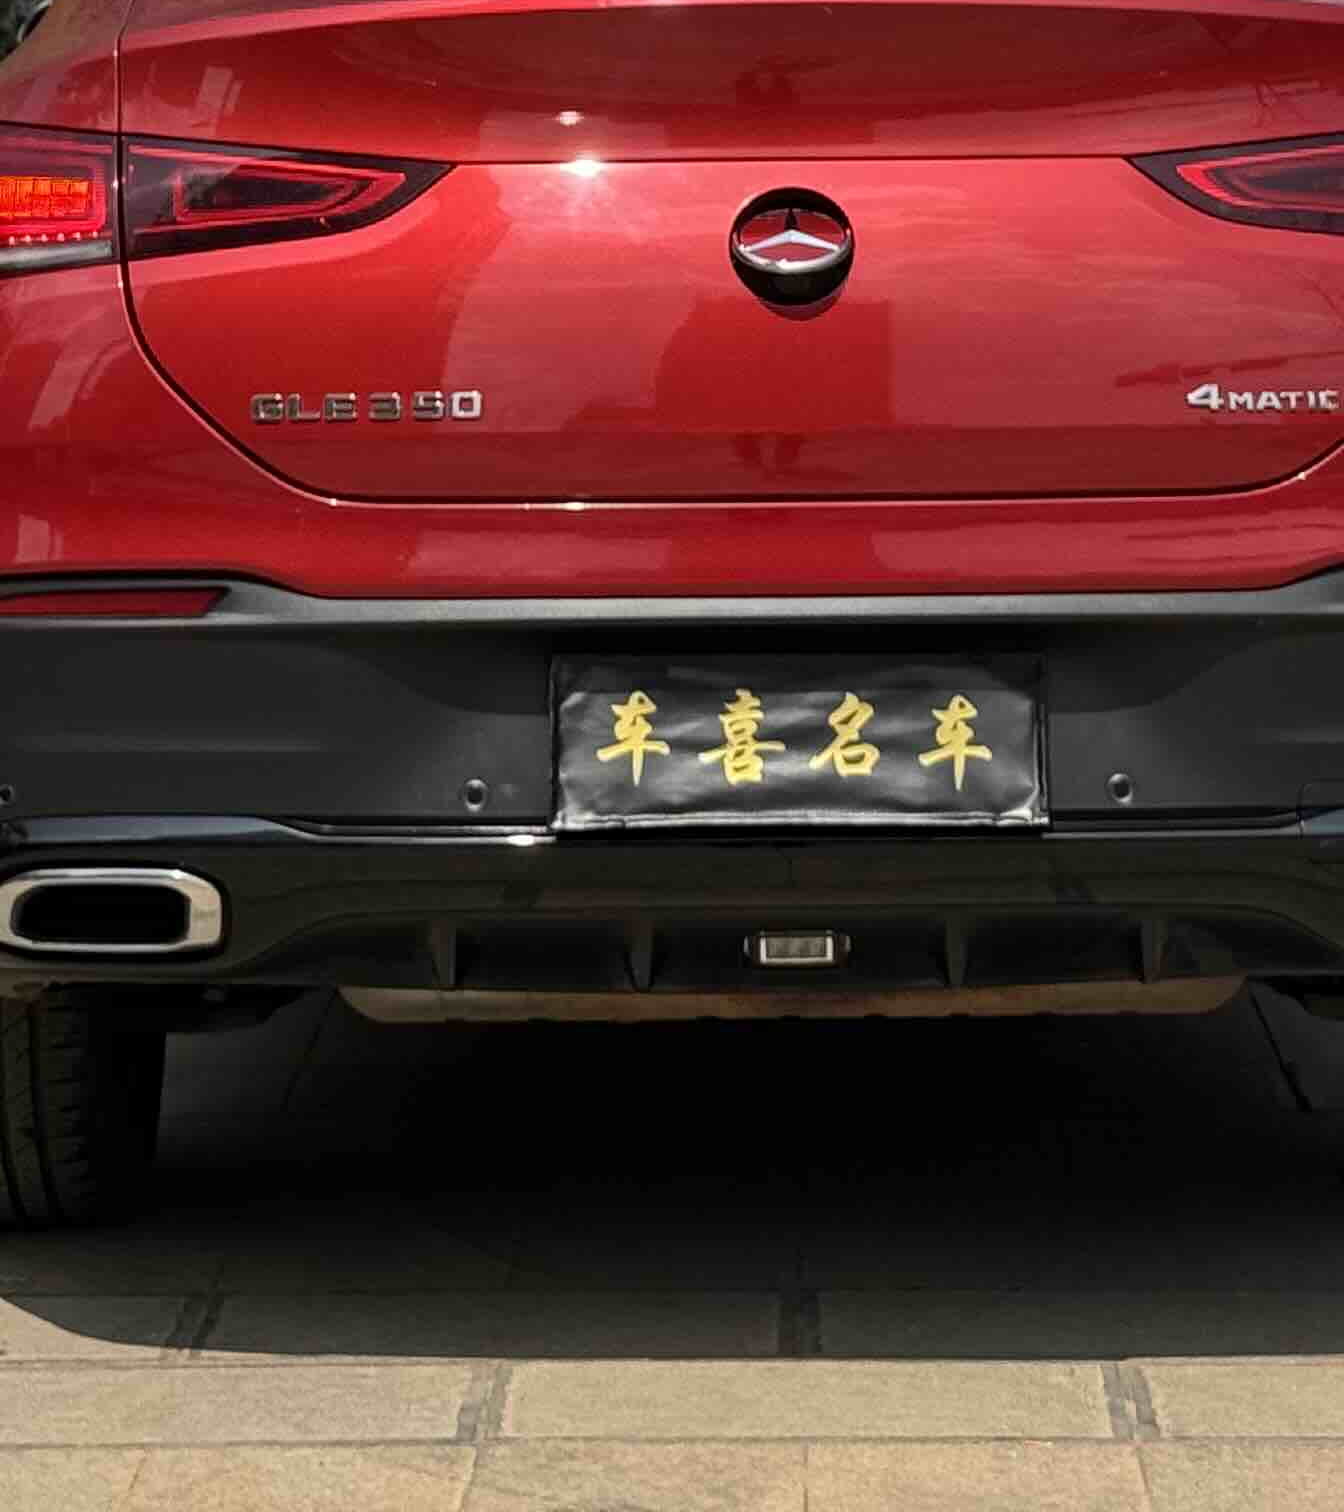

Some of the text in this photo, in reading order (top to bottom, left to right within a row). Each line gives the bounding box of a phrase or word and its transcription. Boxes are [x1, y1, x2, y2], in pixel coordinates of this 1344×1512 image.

[1186, 383, 1340, 410] 4MATIC
[596, 688, 993, 790] 车喜名车
